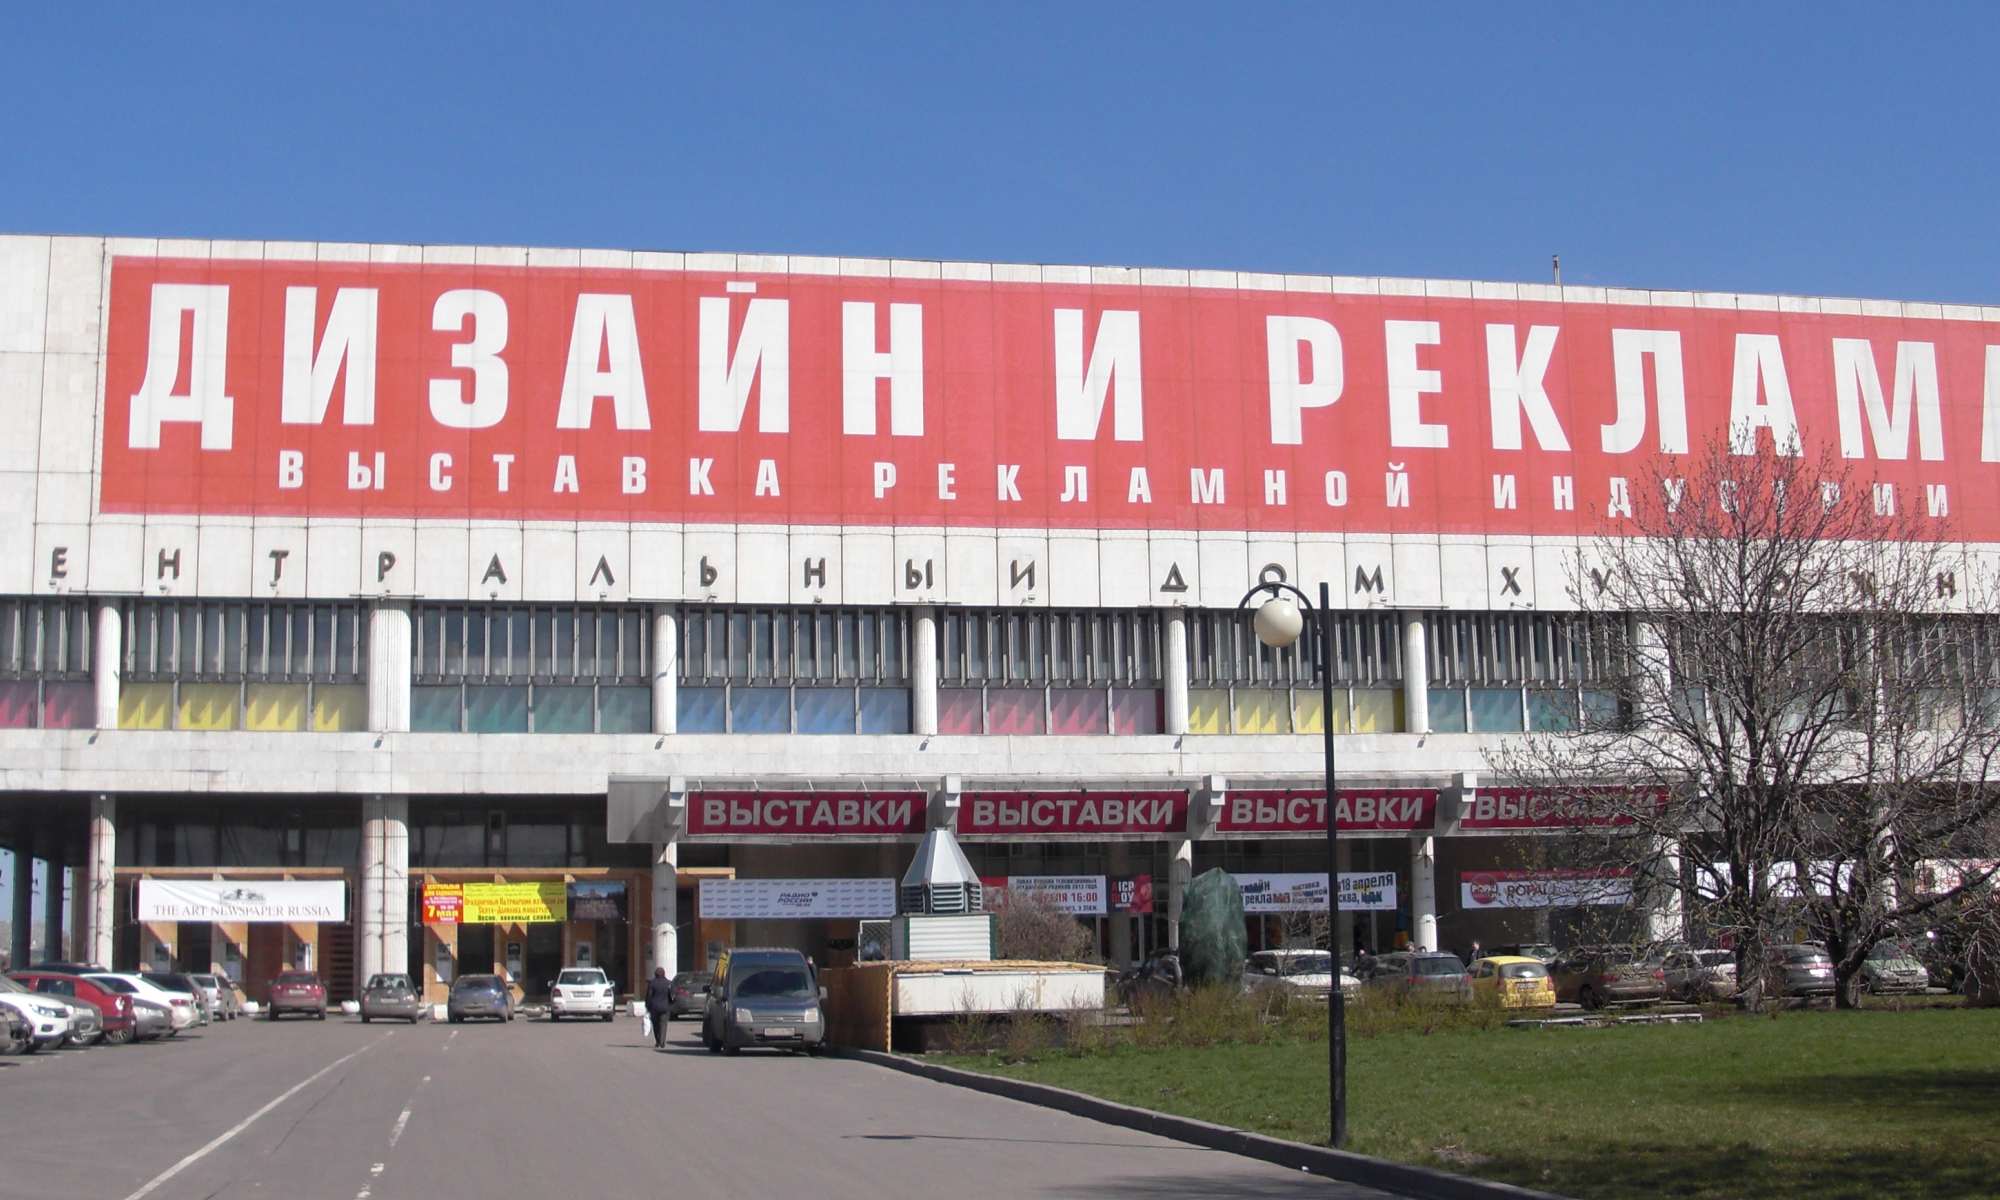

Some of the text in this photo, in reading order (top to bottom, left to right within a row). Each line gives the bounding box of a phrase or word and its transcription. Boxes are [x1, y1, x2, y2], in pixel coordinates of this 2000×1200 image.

[128, 281, 2000, 464] ДИЗАЙН И РЕКЛАМ
[278, 450, 781, 497] ВЫСТАВКА
[873, 461, 1410, 508] РЕКЛАМНОЙ
[1159, 560, 1386, 595] ДОМ
[703, 800, 911, 825] ВЫСТАВКИ
[973, 800, 1173, 824] ВЫСТАВКИ
[1231, 797, 1423, 824] ВЫСТАВКИ
[1353, 874, 1394, 891] апреля
[1071, 892, 1098, 902] 16:00
[155, 904, 331, 917] THE ART NEWSPAPER RUSSIA
